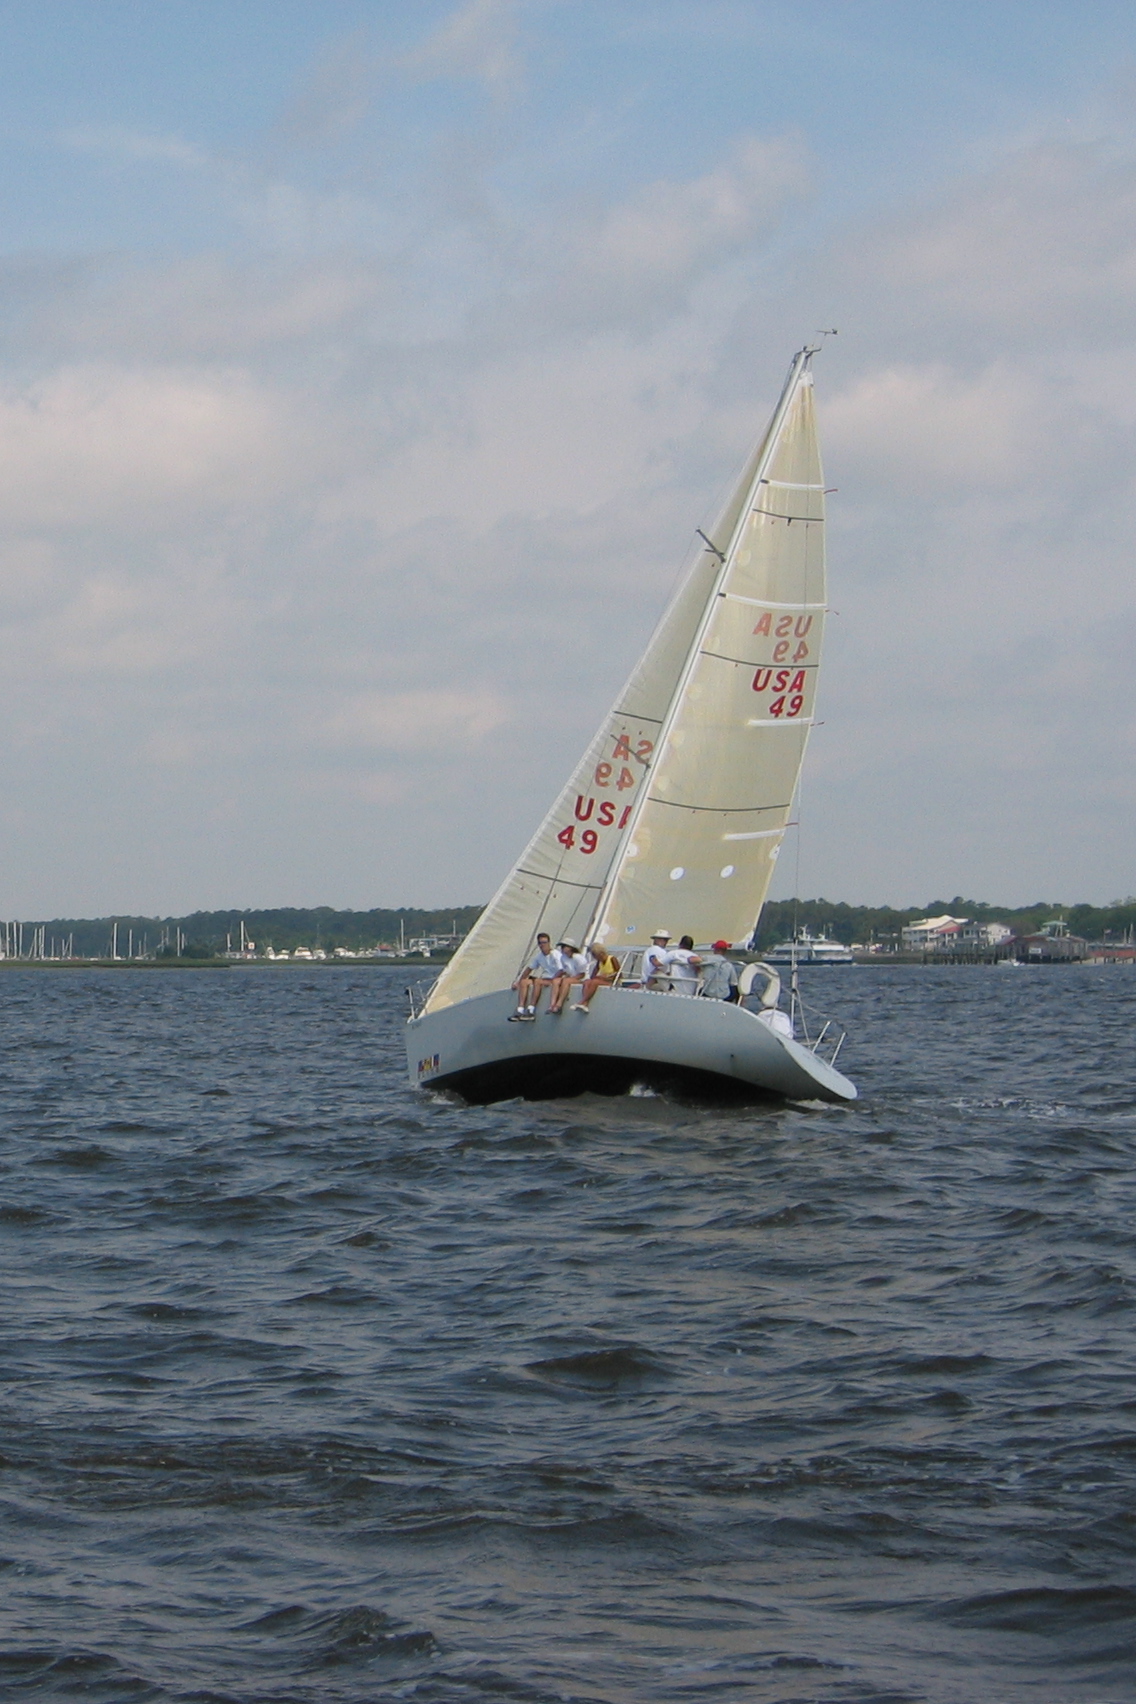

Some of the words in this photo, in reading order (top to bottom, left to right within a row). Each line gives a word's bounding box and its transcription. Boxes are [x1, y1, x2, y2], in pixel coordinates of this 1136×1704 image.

[752, 668, 806, 693] USA
[769, 694, 804, 718] 49
[557, 824, 599, 854] 49
